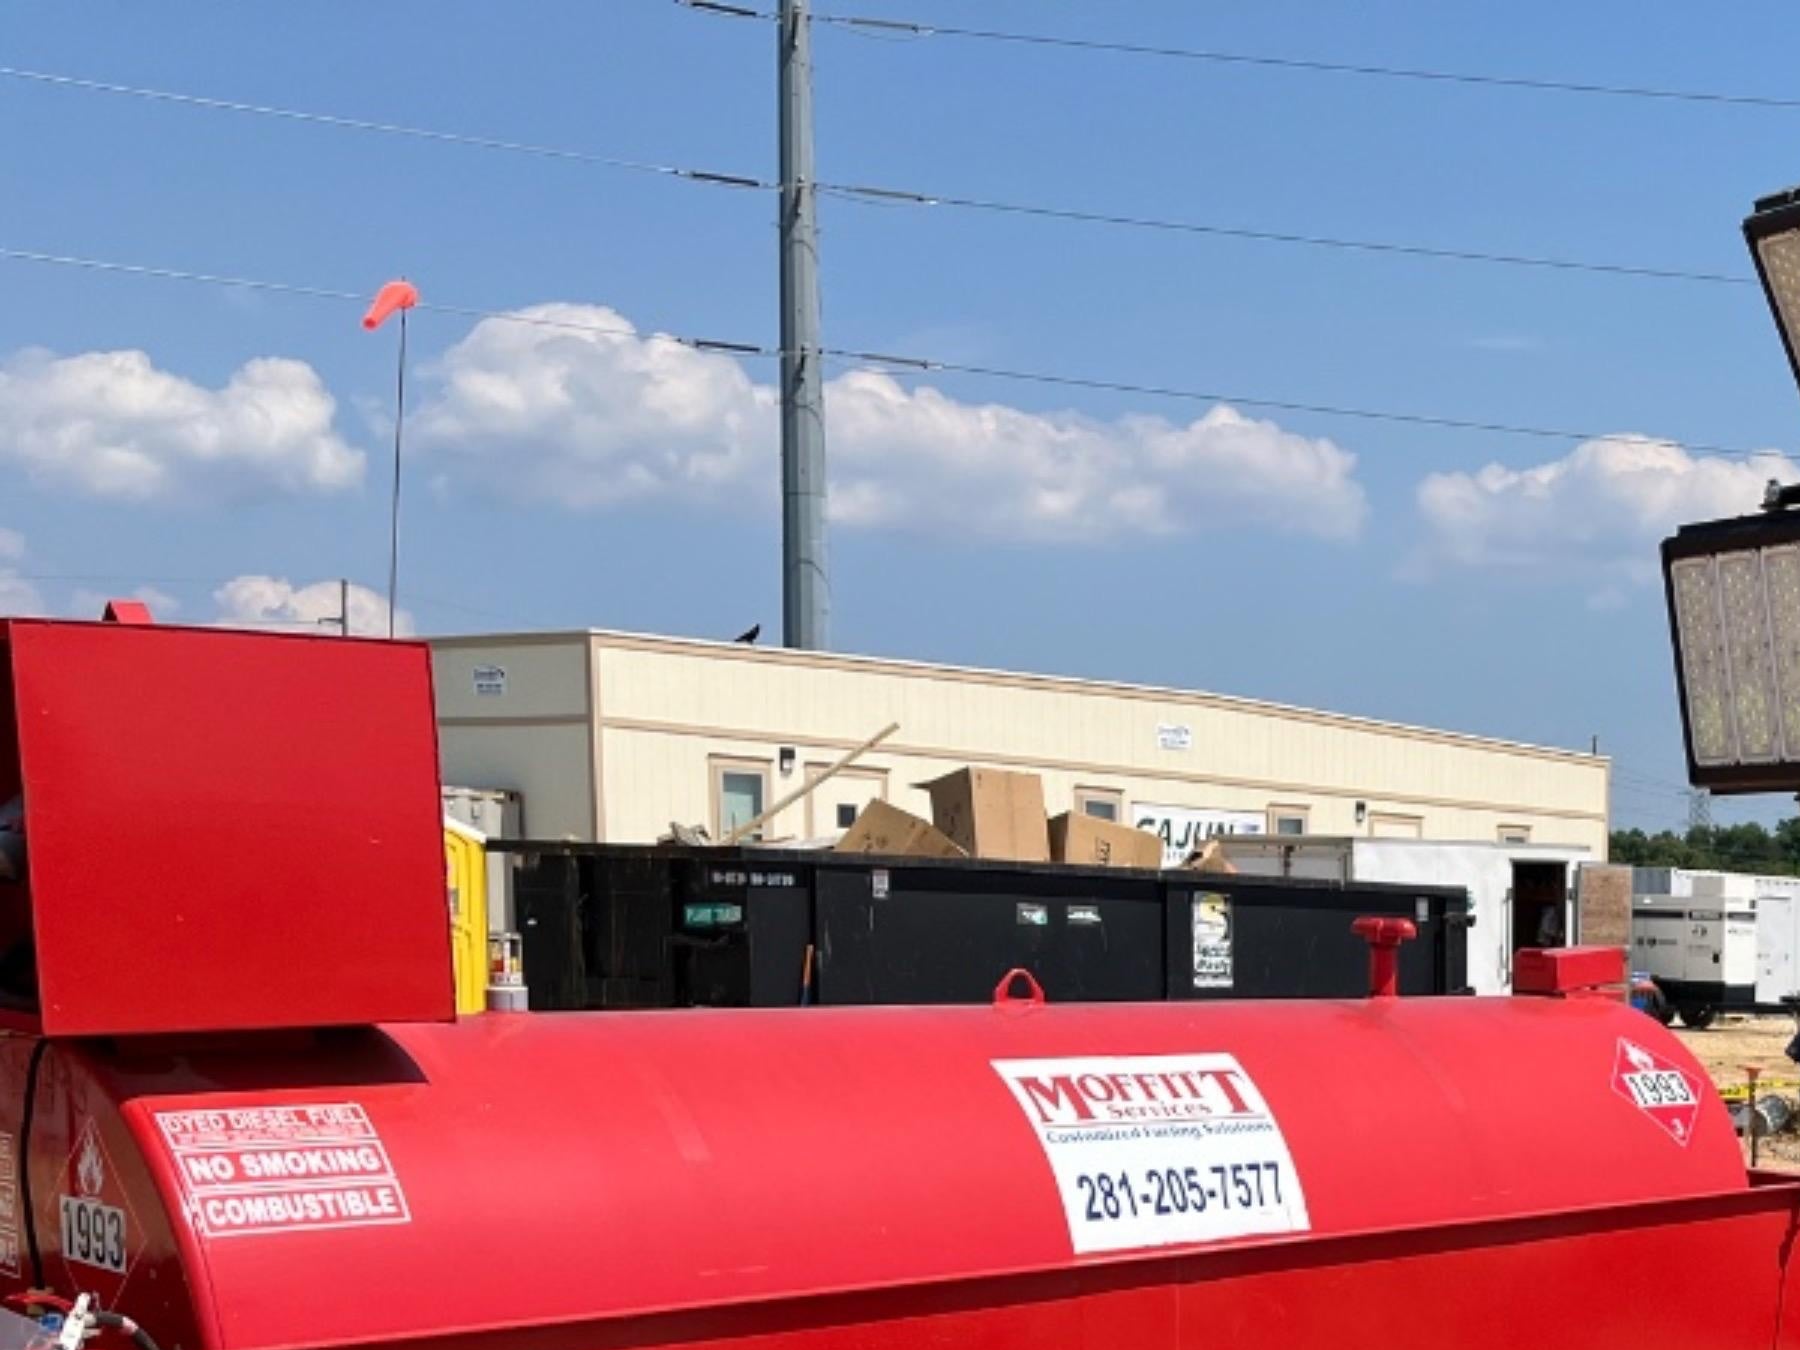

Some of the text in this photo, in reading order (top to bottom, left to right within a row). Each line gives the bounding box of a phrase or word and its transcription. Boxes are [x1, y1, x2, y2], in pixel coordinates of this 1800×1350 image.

[1014, 1070, 1247, 1122] MOFFITT
[1627, 1072, 1690, 1105] 1993
[1107, 1101, 1213, 1120] Services
[186, 1147, 381, 1181] NO SMOKING
[205, 1187, 398, 1226] COMBUSTIBLE
[1076, 1161, 1282, 1221] 281-205-7577
[63, 1200, 124, 1269] 1993
